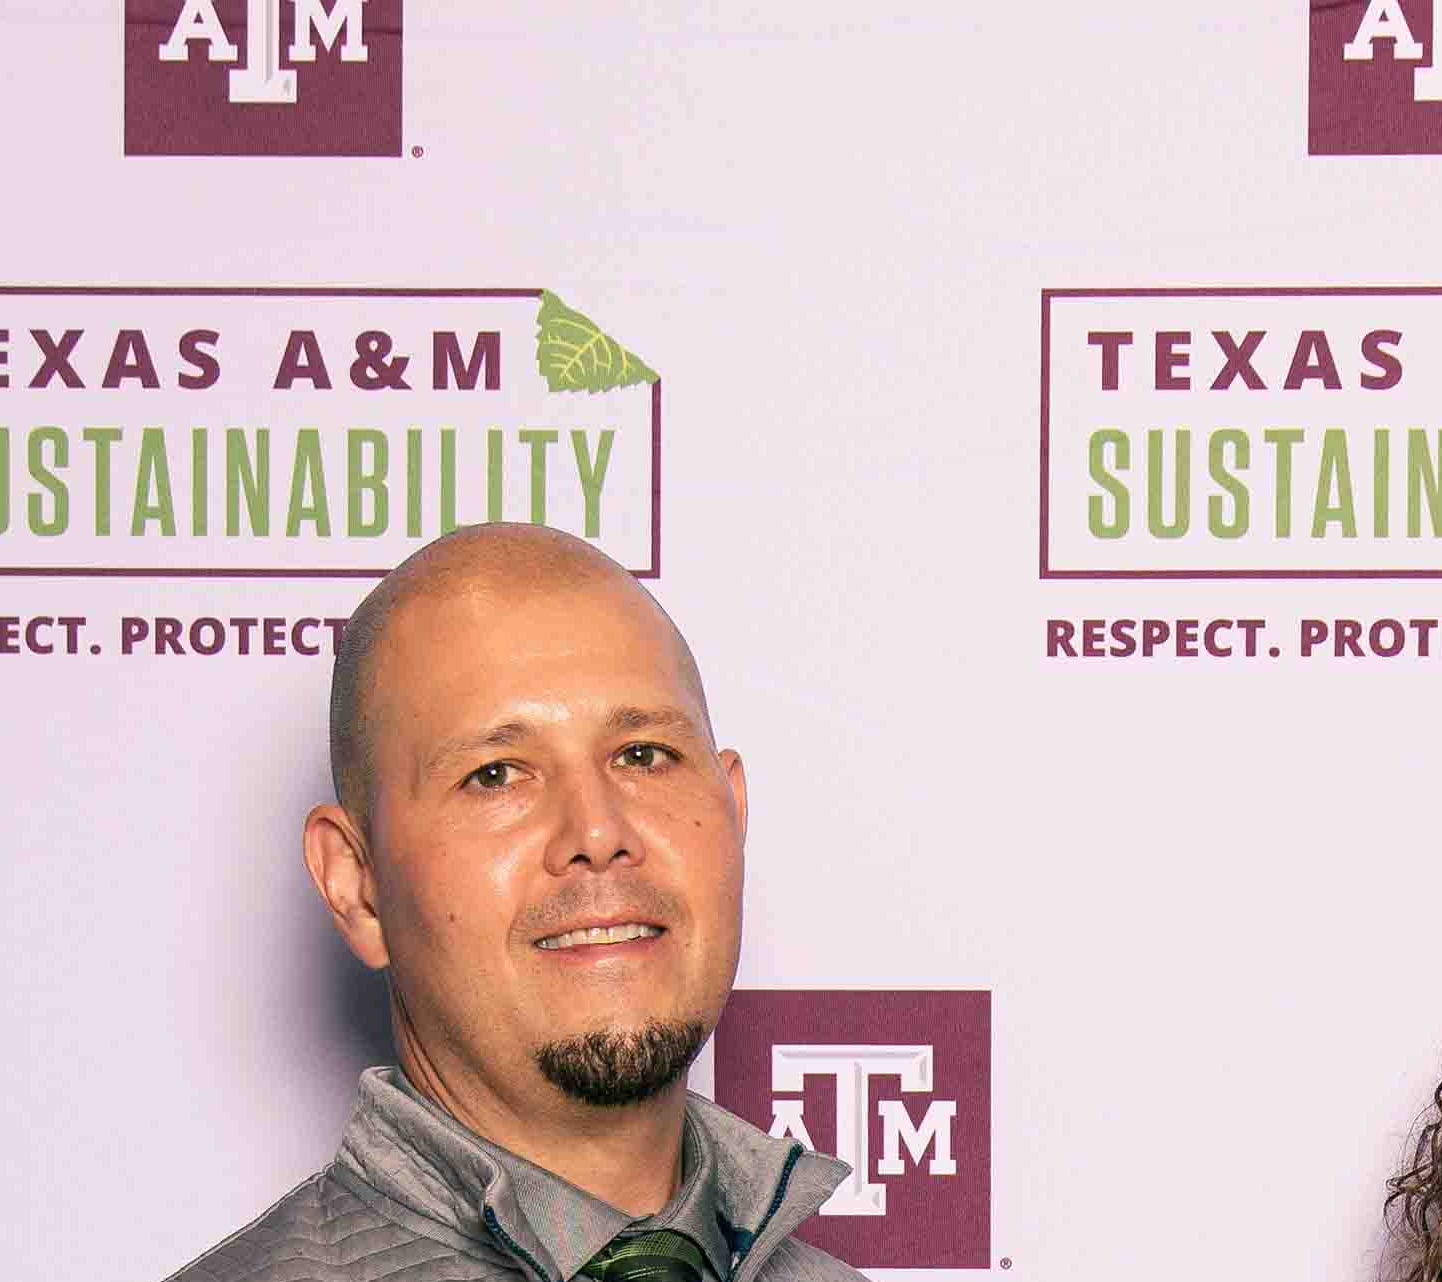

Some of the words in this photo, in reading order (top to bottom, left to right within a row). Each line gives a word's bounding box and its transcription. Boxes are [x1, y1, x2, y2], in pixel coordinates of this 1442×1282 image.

[273, 330, 500, 390] A&M
[1088, 330, 1402, 390] TEXAS
[1047, 619, 1280, 657] RESPECT.
